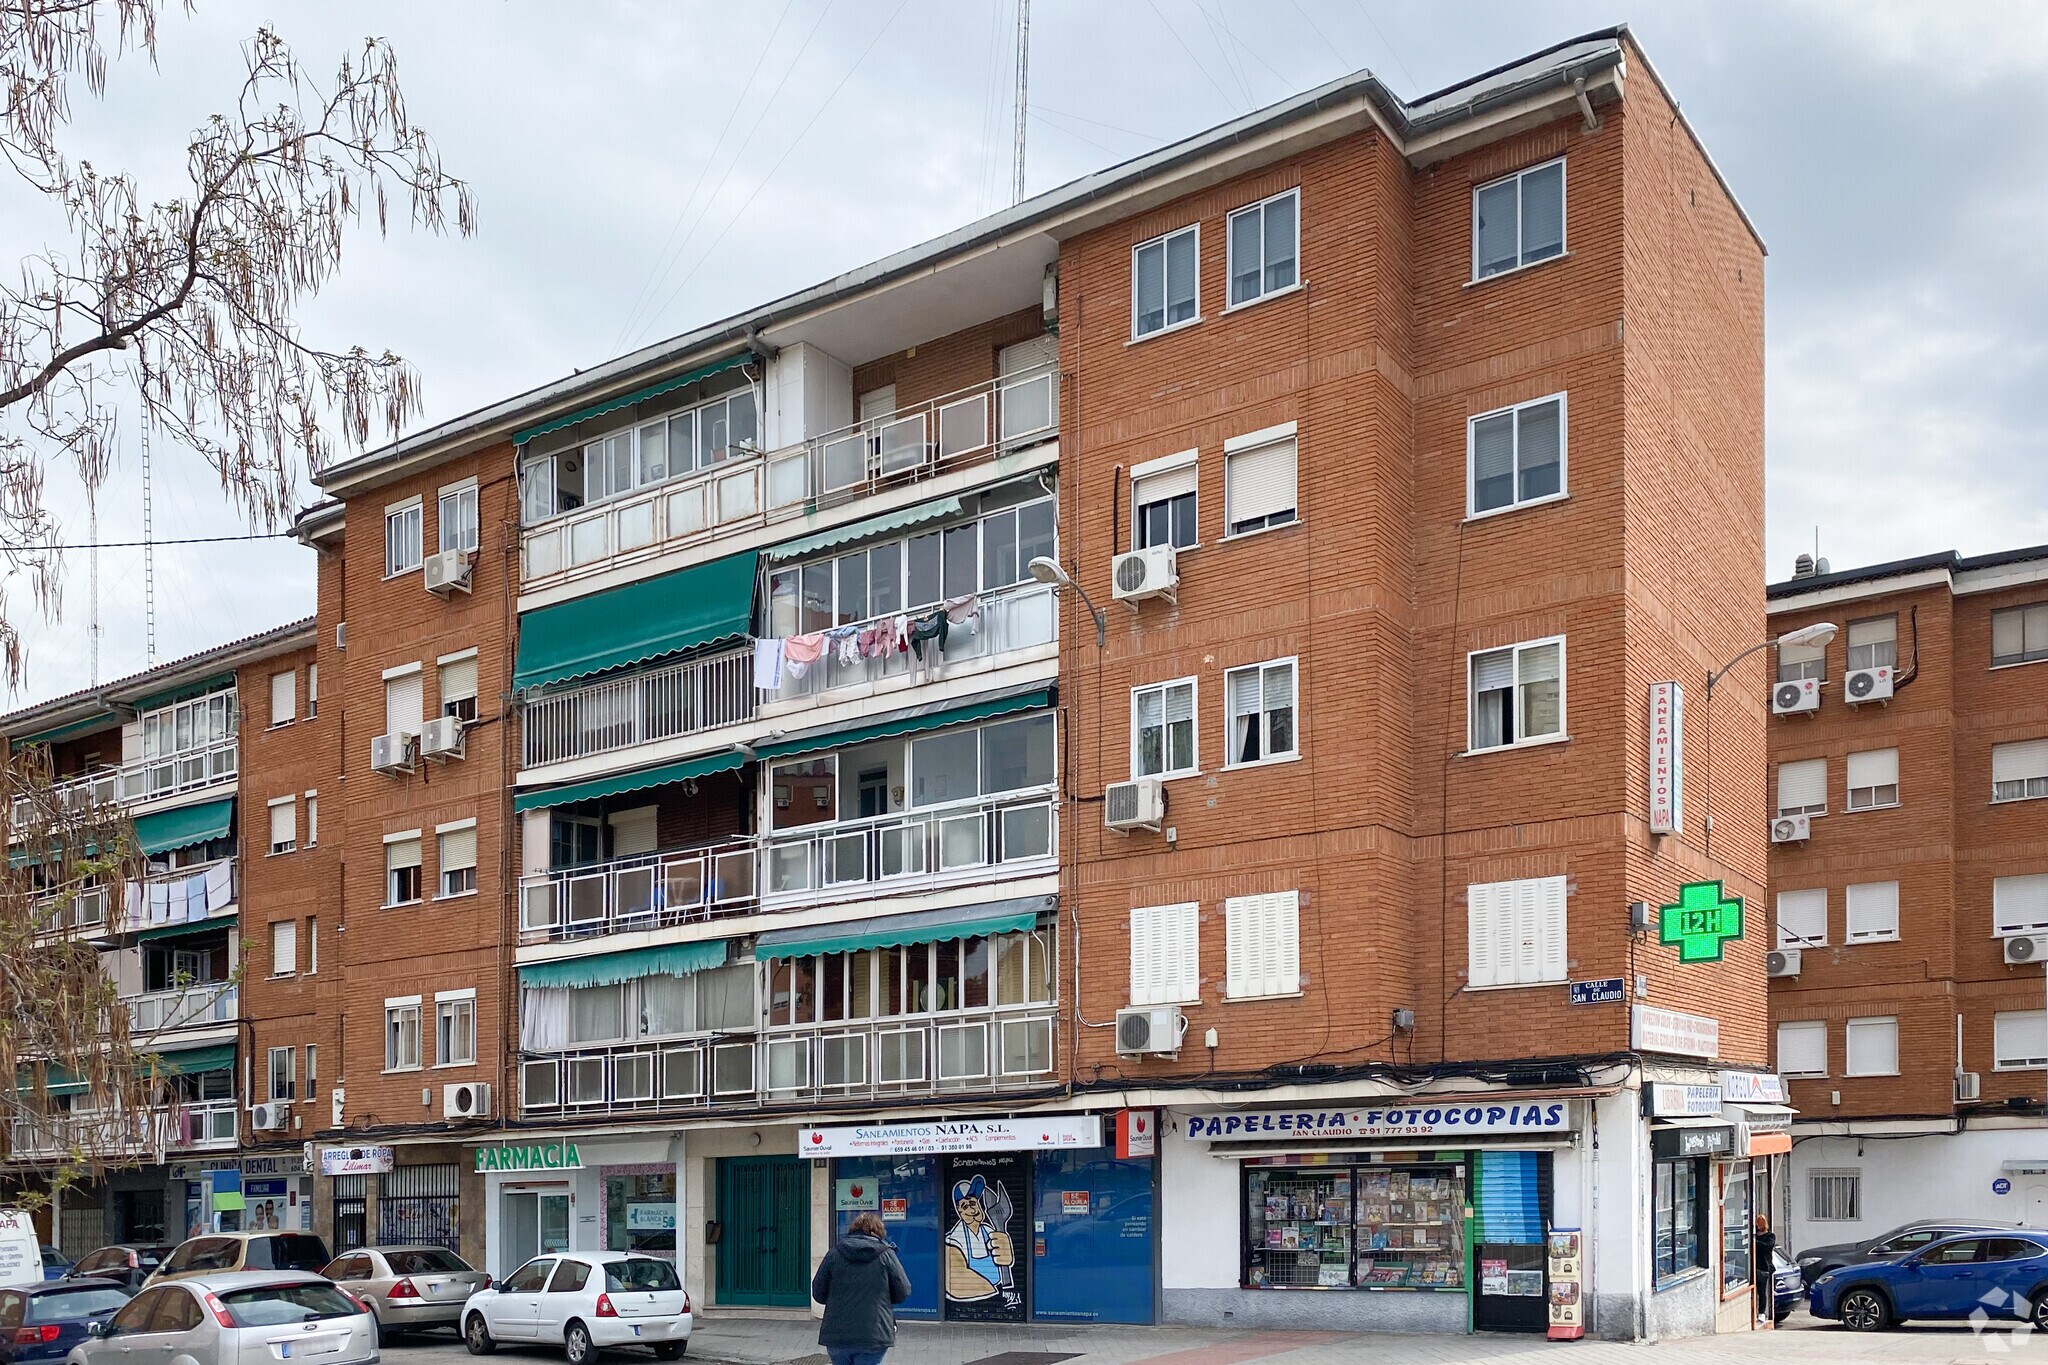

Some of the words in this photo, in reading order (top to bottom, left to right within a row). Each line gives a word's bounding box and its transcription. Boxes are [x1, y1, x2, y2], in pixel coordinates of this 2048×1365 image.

[1656, 687, 1668, 805] SANEAMIENTOS
[1654, 808, 1669, 827] NAPA
[1682, 910, 1720, 934] 12H
[1572, 994, 1586, 1002] SAN
[1592, 990, 1622, 1000] CLAUDIO
[1687, 1087, 1718, 1099] PAPELERIA
[1688, 1101, 1720, 1112] FOTOCOPIAS
[1188, 1112, 1346, 1137] PAPELERIA
[1367, 1105, 1564, 1126] FOTOCOPIAS
[856, 1128, 931, 1139] SANEAMIENTOS
[986, 1124, 1010, 1133] S.L.
[475, 1144, 583, 1170] FARMACIA
[246, 1158, 278, 1174] DENTAL
[342, 1161, 372, 1171] Lilimar
[251, 1184, 270, 1192] FAMILIAR
